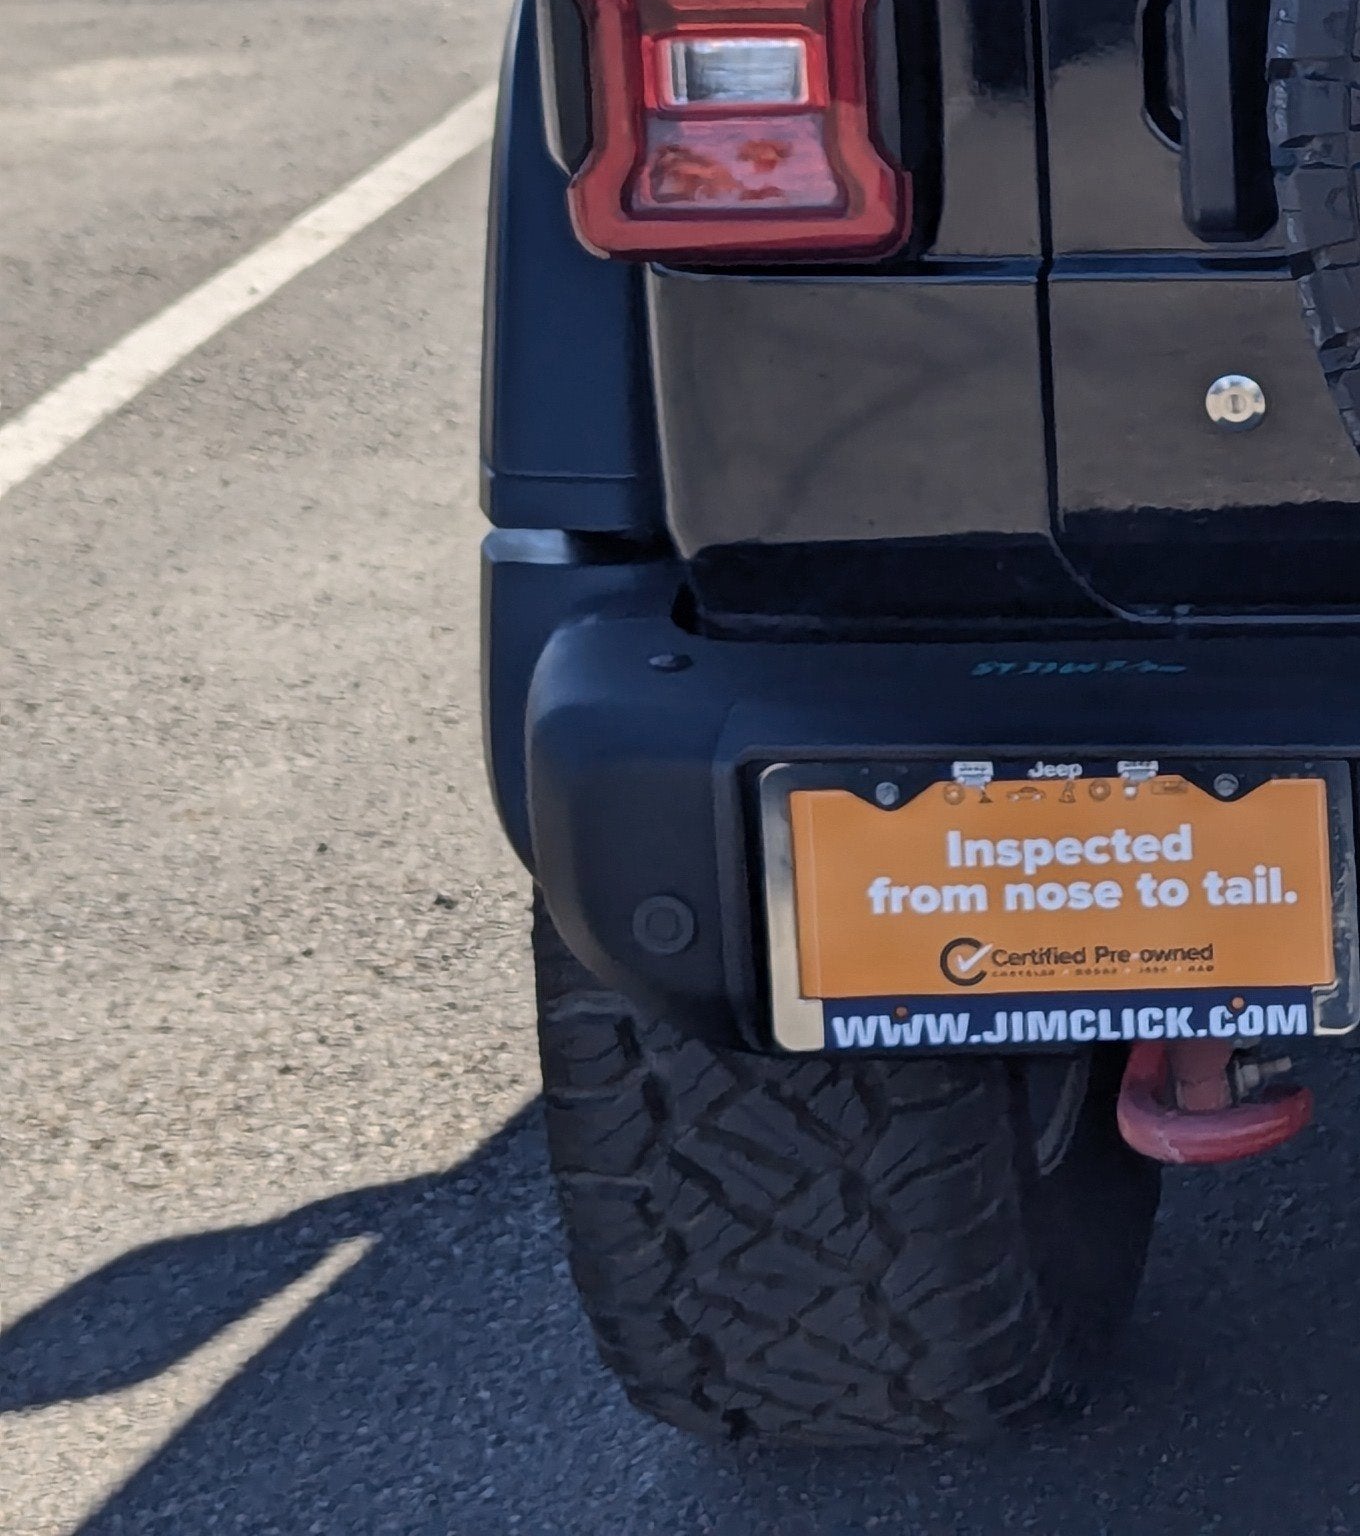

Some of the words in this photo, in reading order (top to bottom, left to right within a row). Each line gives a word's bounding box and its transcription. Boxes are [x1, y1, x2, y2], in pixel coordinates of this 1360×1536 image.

[1027, 761, 1082, 780] Jeep
[946, 823, 1193, 875] Inspected
[868, 876, 988, 914] from
[1004, 880, 1123, 911] nose
[1136, 872, 1190, 907] to
[1203, 864, 1298, 905] tail.
[991, 947, 1086, 967] Certified
[831, 1004, 1308, 1048] WWW.JIMCLICK.COM
